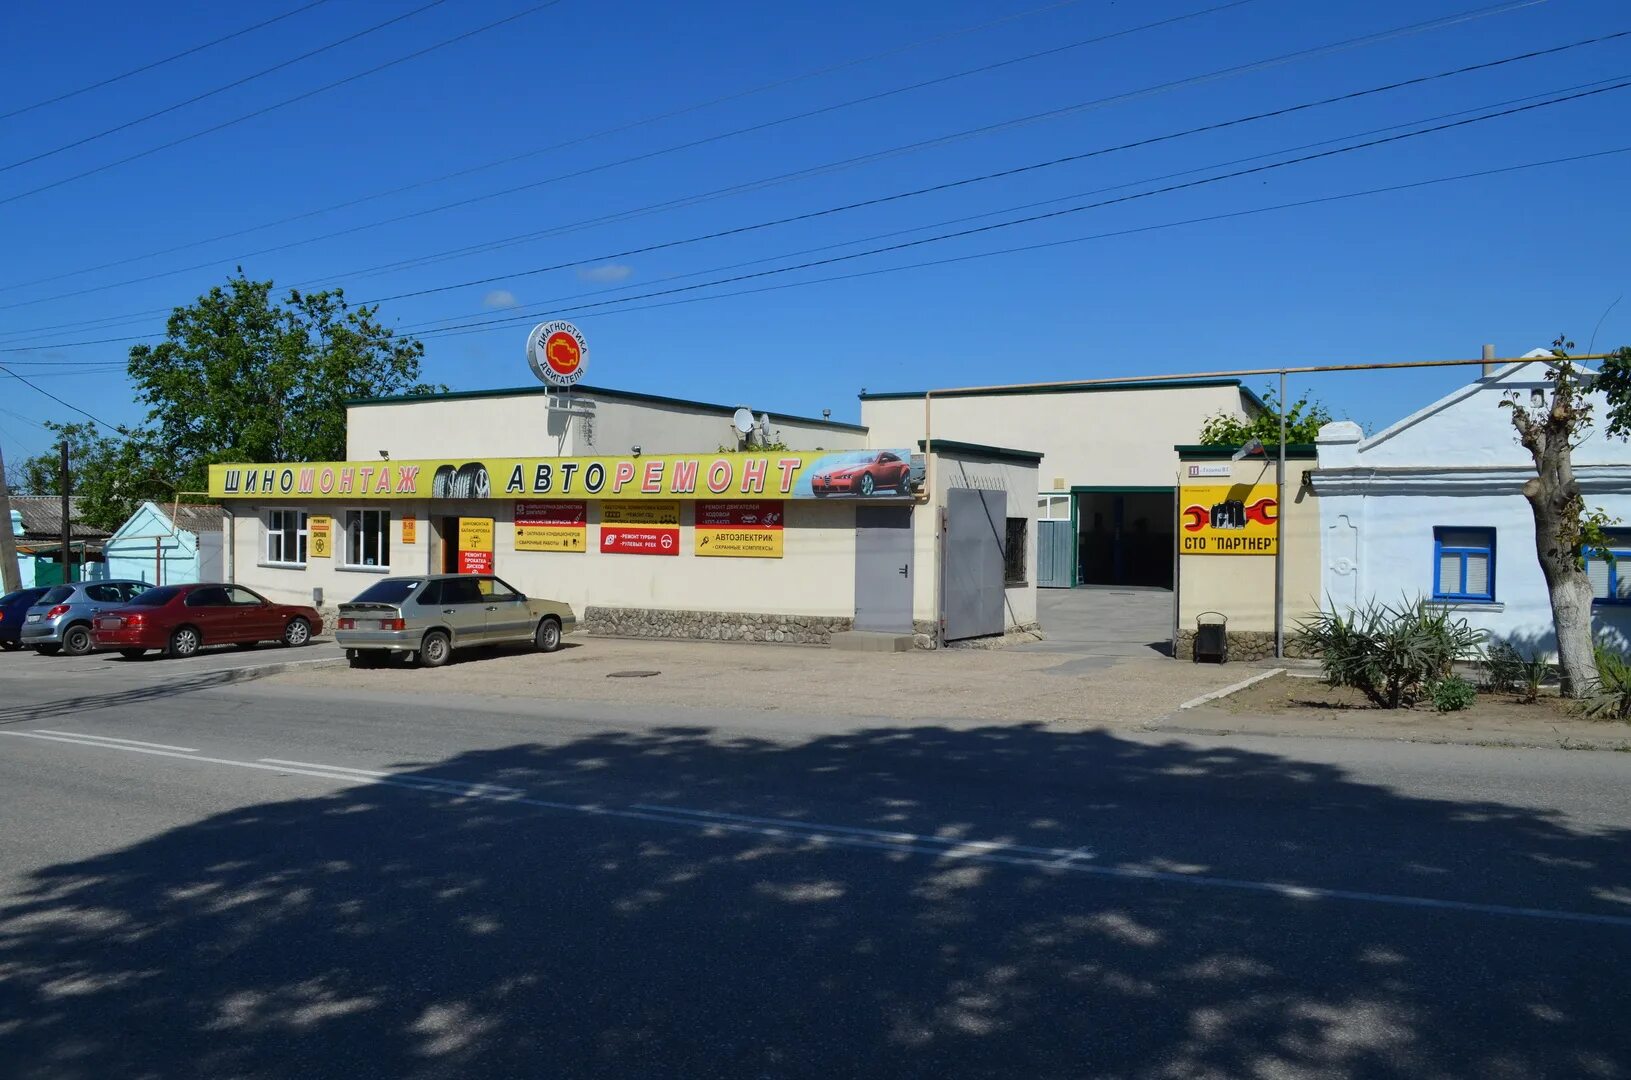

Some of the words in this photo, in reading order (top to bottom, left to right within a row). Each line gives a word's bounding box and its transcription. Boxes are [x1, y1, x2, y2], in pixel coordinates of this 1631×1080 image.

[538, 322, 587, 354] ДИАГНОСТИКА
[540, 361, 584, 384] ДВИГАТЕЛЯ
[224, 465, 421, 494] ШИНОМОНТАЖ
[505, 458, 802, 494] АВТОРЕМОНТ
[715, 533, 773, 542] АВТОЭЛЕКТРИК
[1184, 537, 1206, 549] СТО
[1211, 537, 1278, 550] "ПАРТНЕР"
